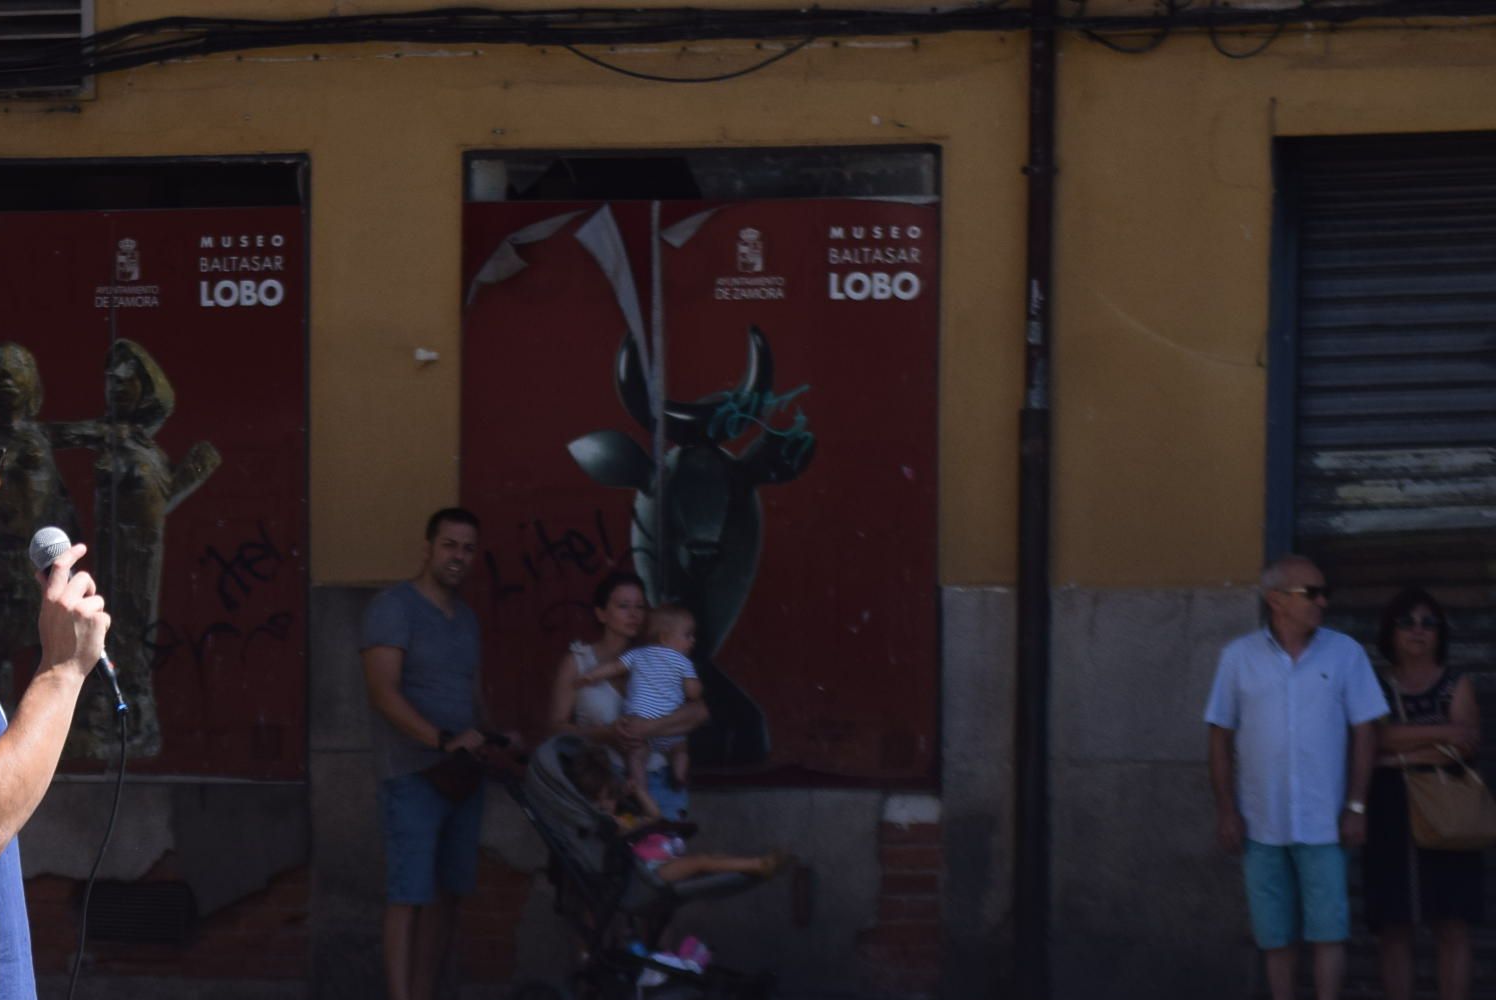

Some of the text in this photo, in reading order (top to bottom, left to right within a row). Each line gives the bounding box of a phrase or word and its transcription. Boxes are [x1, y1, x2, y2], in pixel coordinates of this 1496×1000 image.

[829, 225, 921, 239] MUSEO
[200, 234, 284, 248] MUSEO
[828, 248, 921, 264] BALTASAR
[199, 256, 284, 272] BALTASAR
[200, 279, 284, 307] LOBO
[828, 271, 921, 300] LOBO
[732, 288, 785, 300] ZAMORA
[113, 296, 159, 308] ZAMORA
